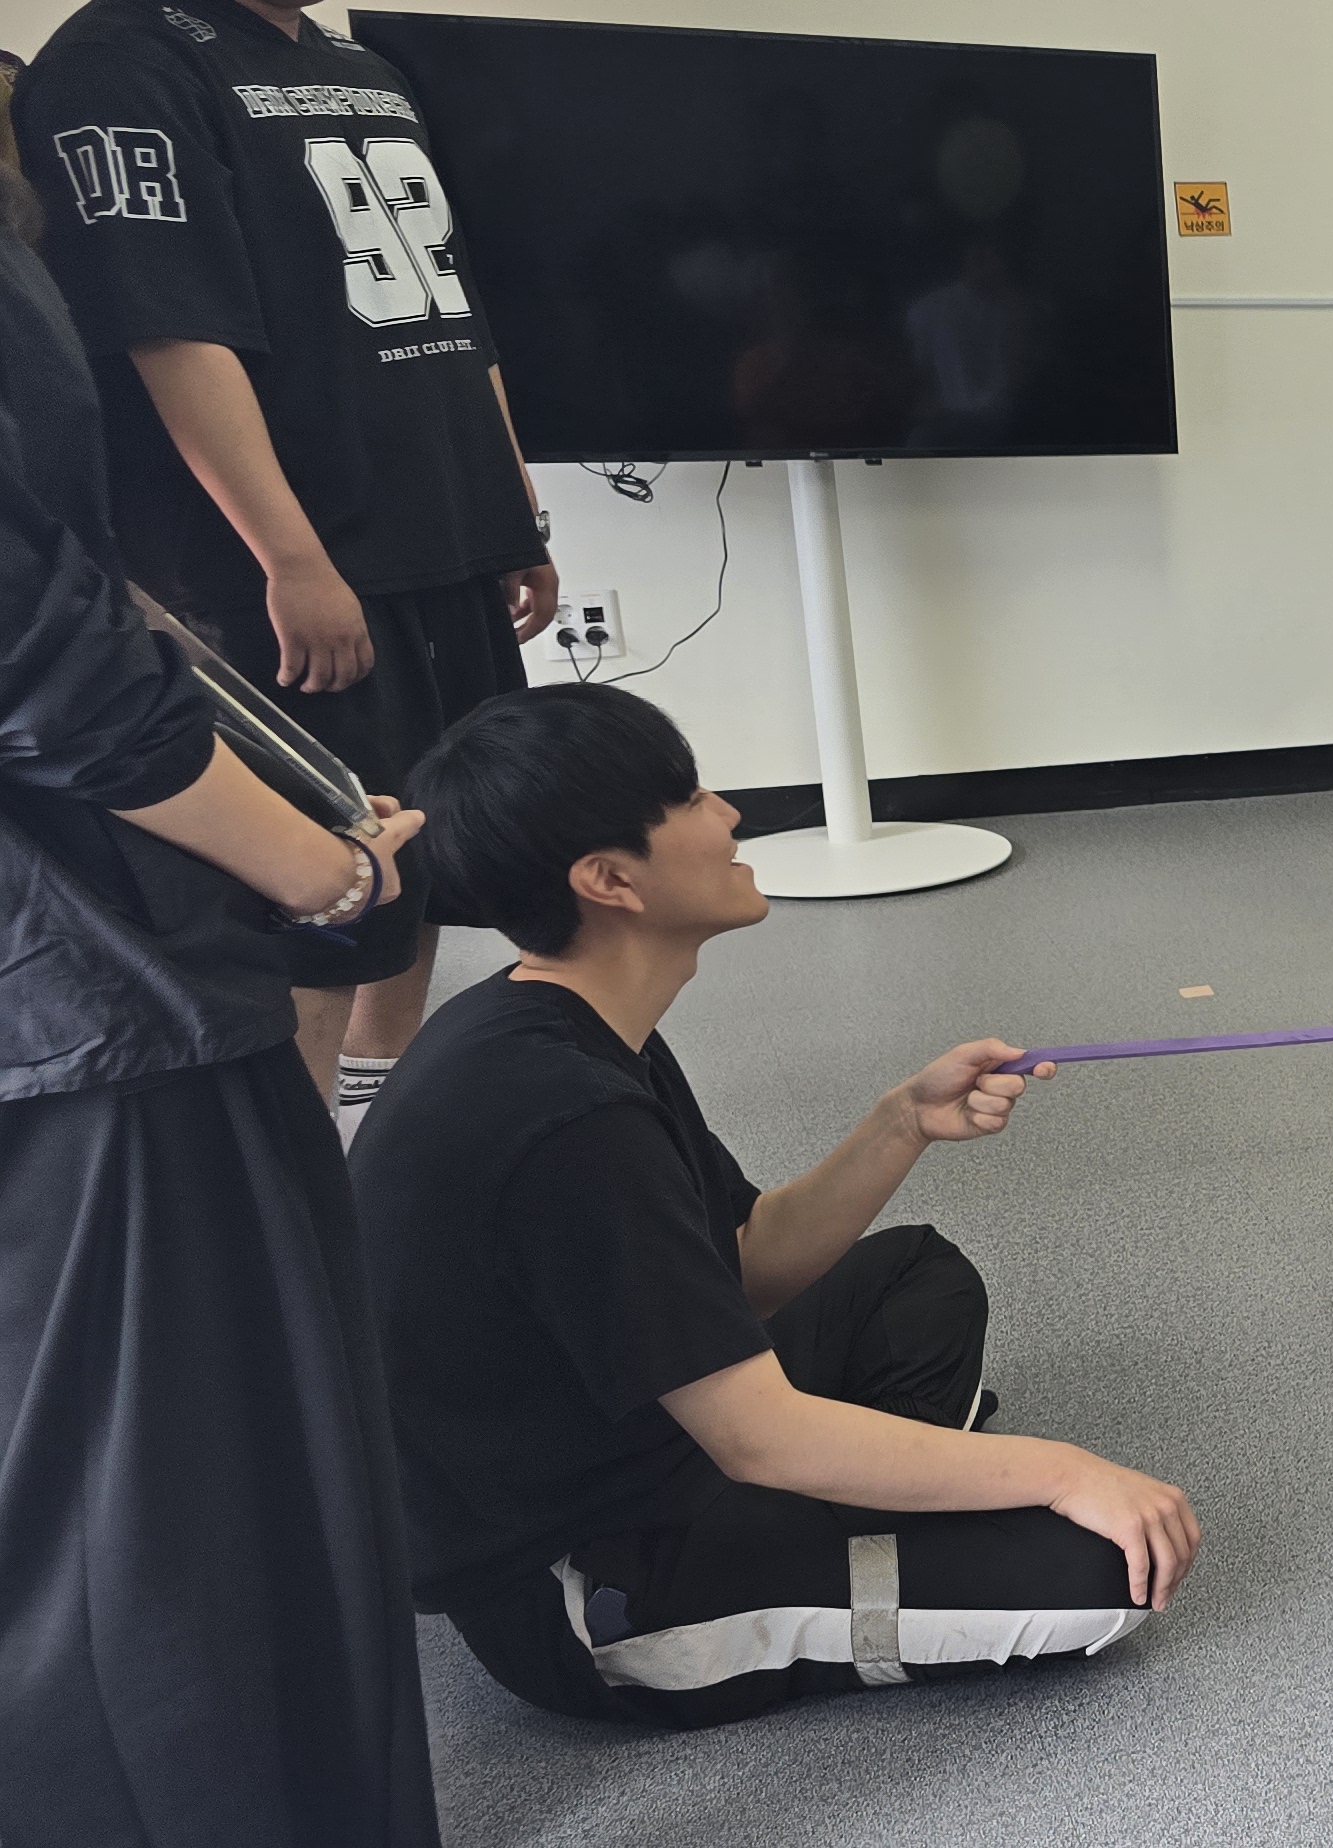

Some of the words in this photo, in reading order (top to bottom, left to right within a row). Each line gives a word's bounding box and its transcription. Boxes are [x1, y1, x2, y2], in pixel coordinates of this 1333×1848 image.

[54, 125, 187, 224] DR
[303, 137, 473, 328] 92
[1184, 220, 1225, 232] 낙상주의
